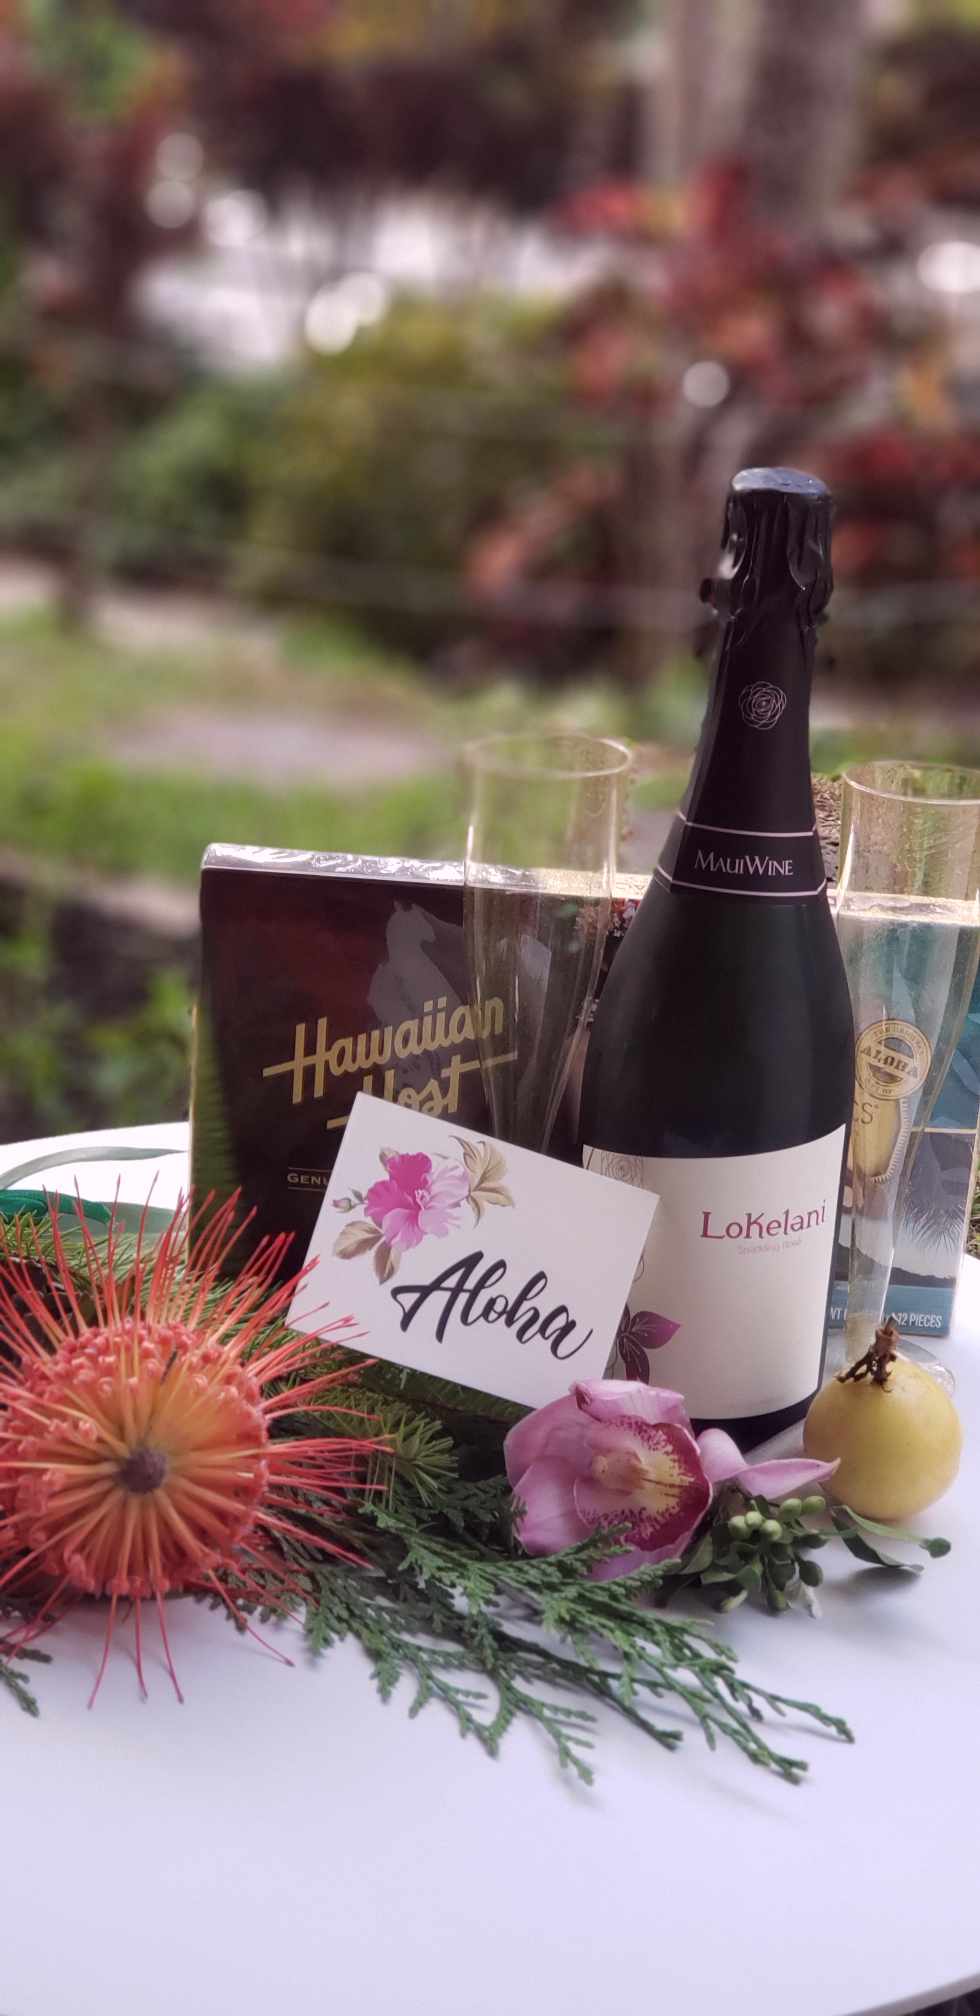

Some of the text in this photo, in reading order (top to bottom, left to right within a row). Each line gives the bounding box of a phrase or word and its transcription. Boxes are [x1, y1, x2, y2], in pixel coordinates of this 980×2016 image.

[262, 996, 505, 1105] Hawaiian
[287, 1172, 330, 1185] GEN
[699, 1199, 826, 1239] LoKelani
[390, 1250, 594, 1360] Aloha
[909, 1312, 943, 1329] PIECES
